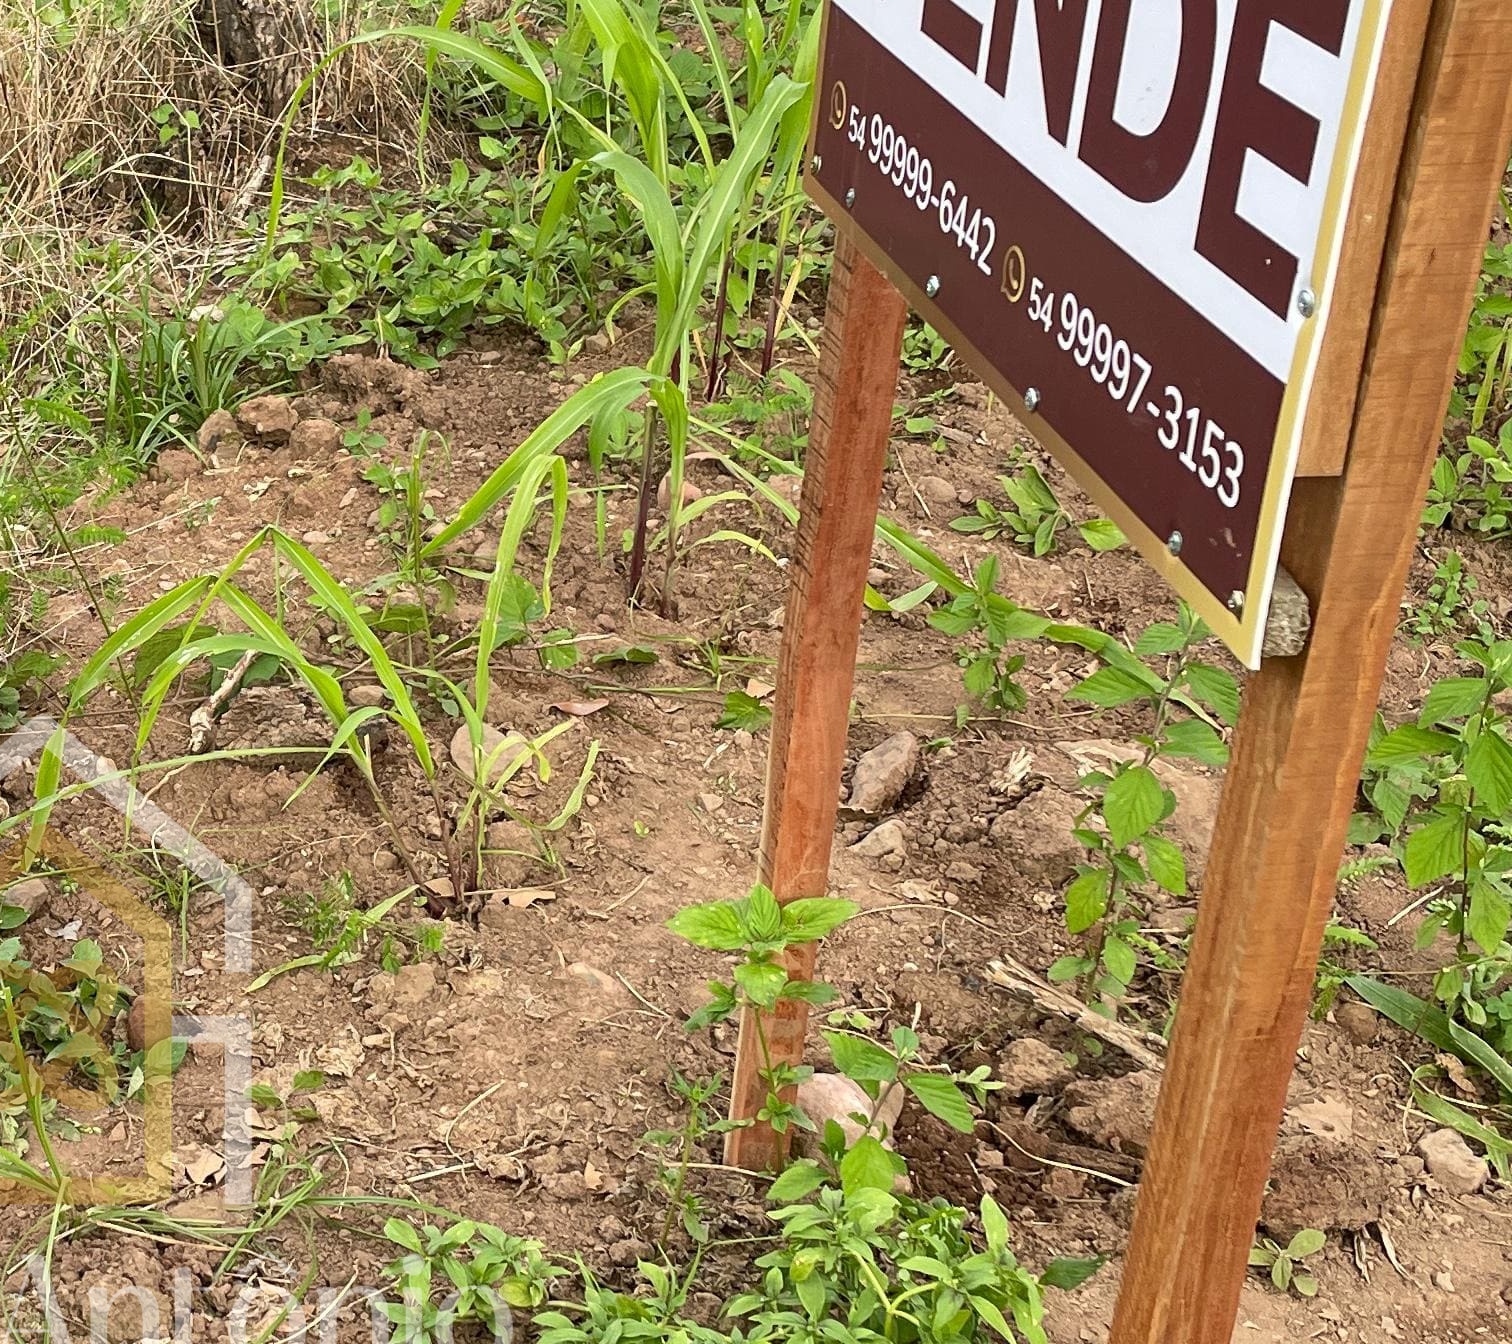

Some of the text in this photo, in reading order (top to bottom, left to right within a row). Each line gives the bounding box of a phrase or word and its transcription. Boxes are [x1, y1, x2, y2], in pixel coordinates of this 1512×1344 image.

[847, 104, 997, 276] 54 99999-6442
[1026, 276, 1245, 509] 54 99997-3153
